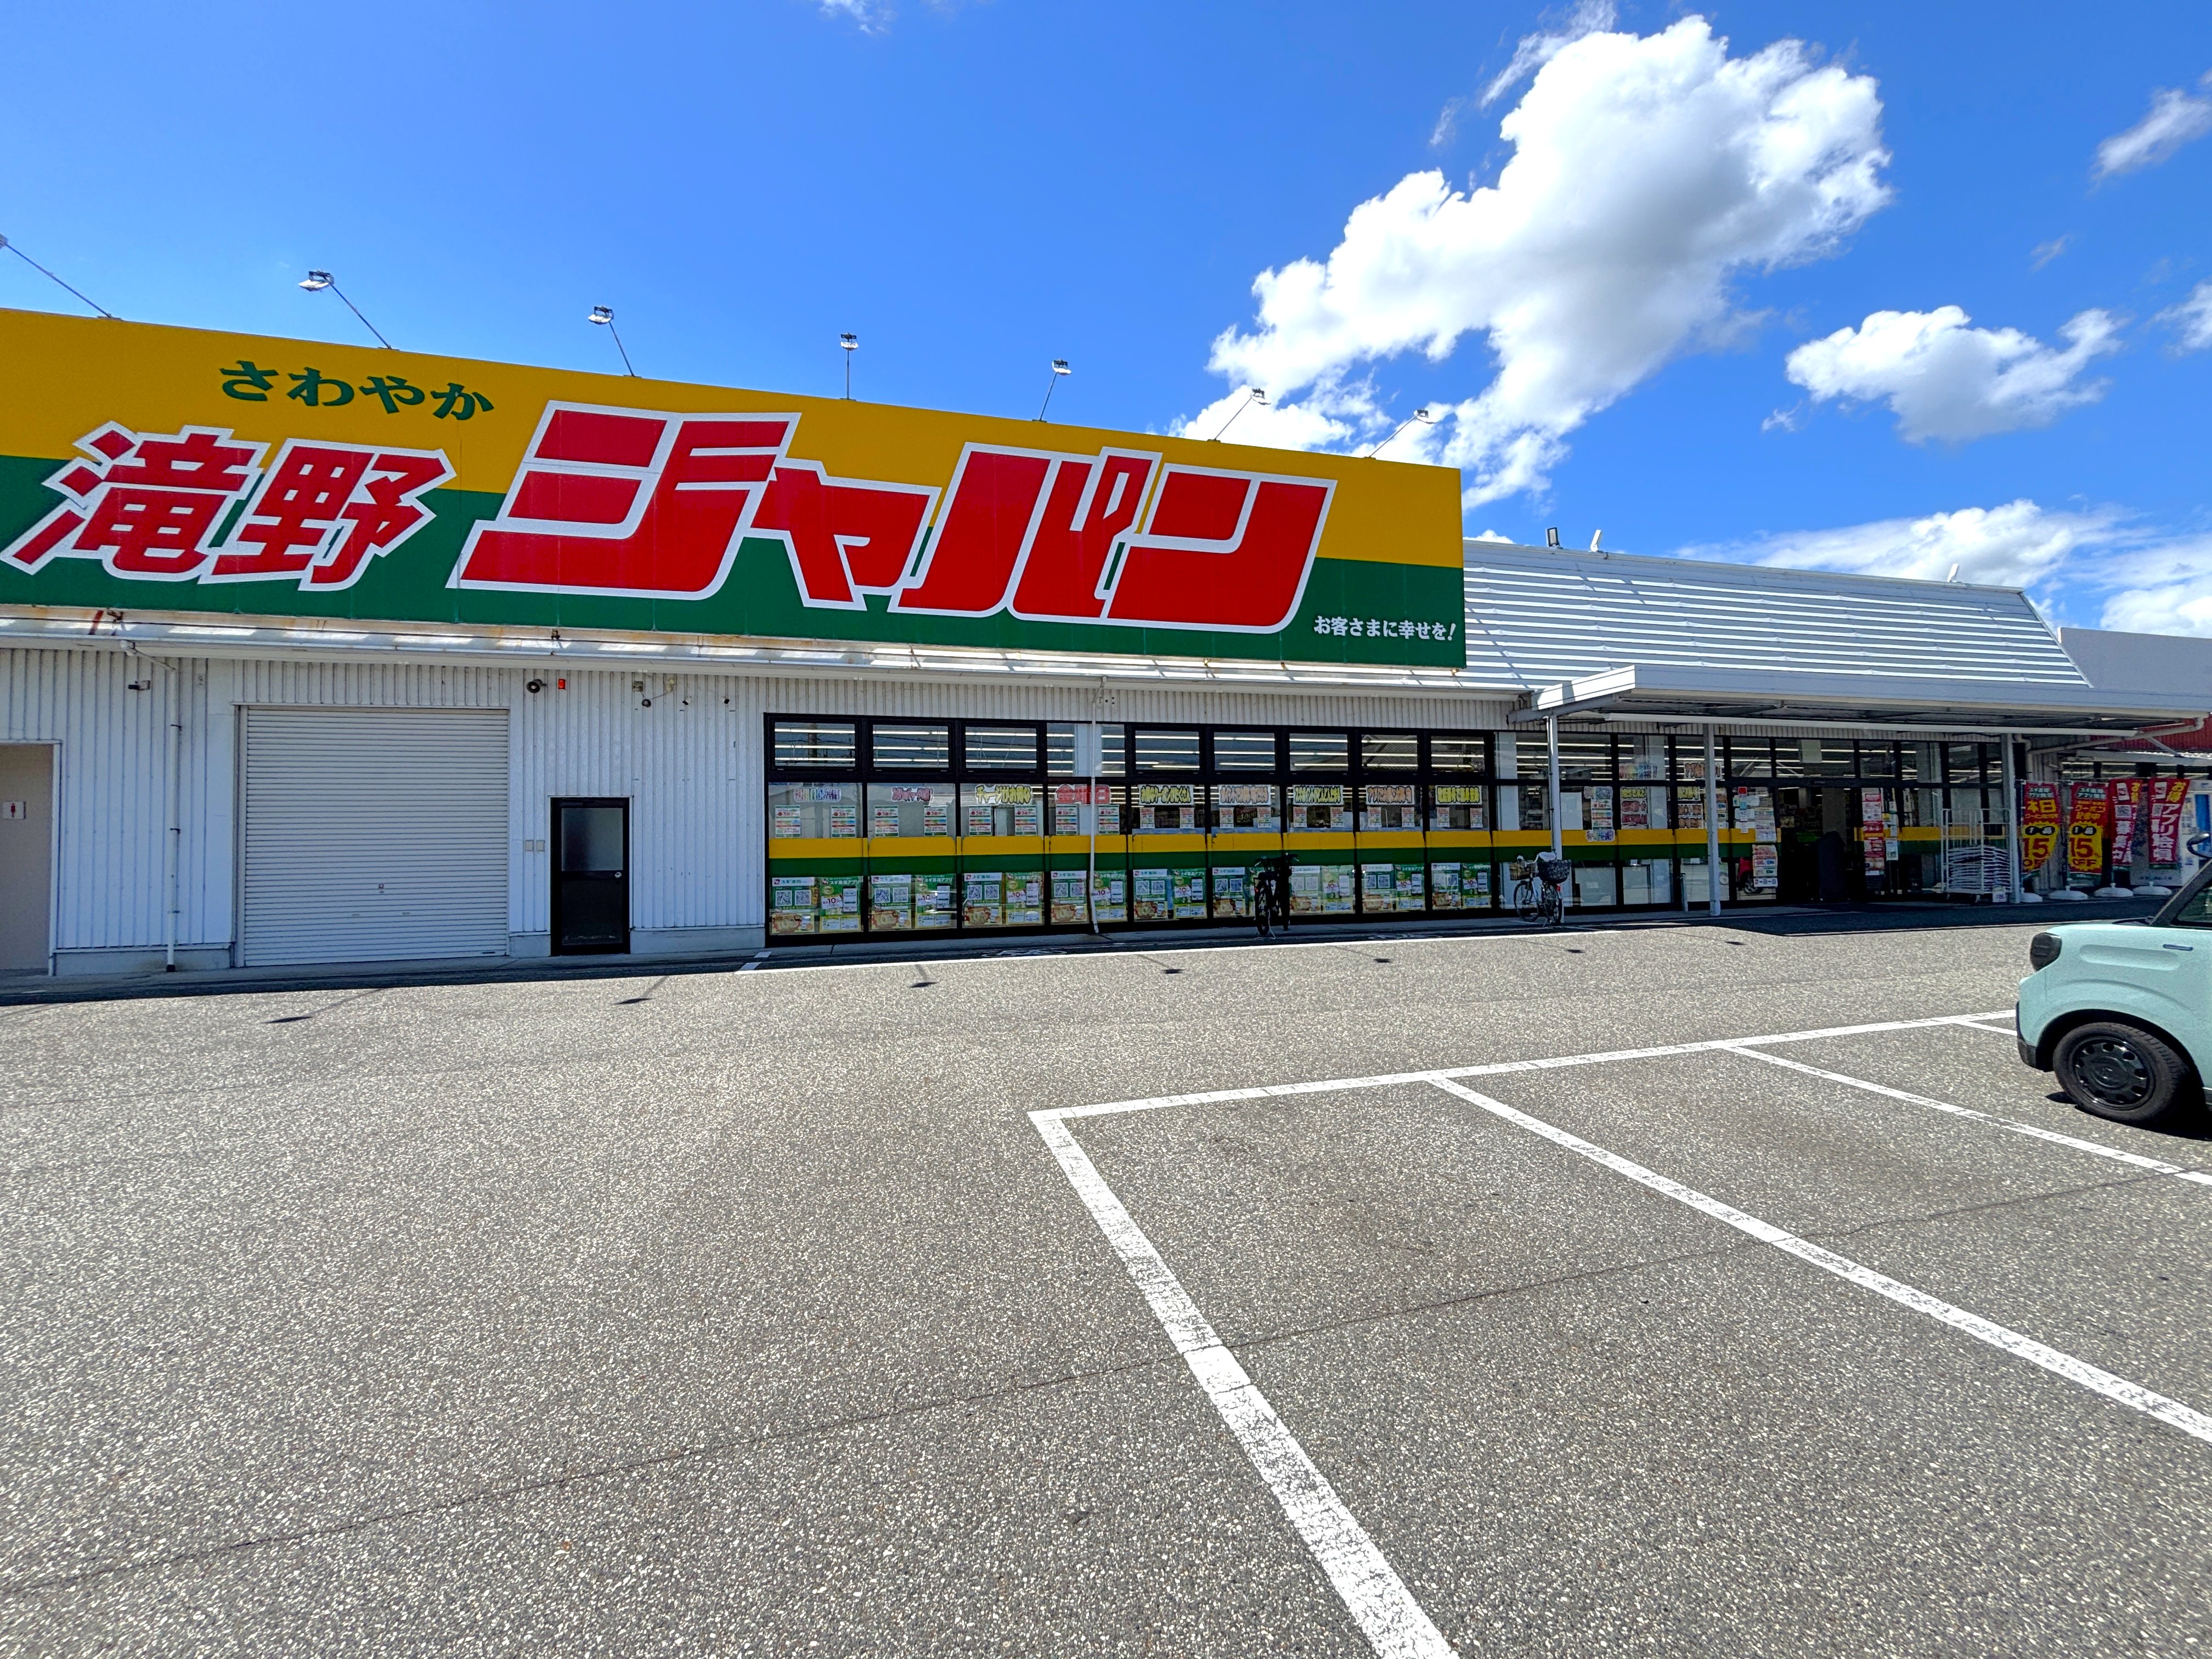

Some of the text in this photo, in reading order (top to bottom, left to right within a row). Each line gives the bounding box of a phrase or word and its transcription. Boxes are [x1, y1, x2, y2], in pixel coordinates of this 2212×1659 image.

[219, 360, 494, 421] さわやか
[0, 400, 1337, 635] 滝野 ジャパン
[1313, 615, 1456, 641] お客さまに幸せを!
[2027, 799, 2056, 813] 本日
